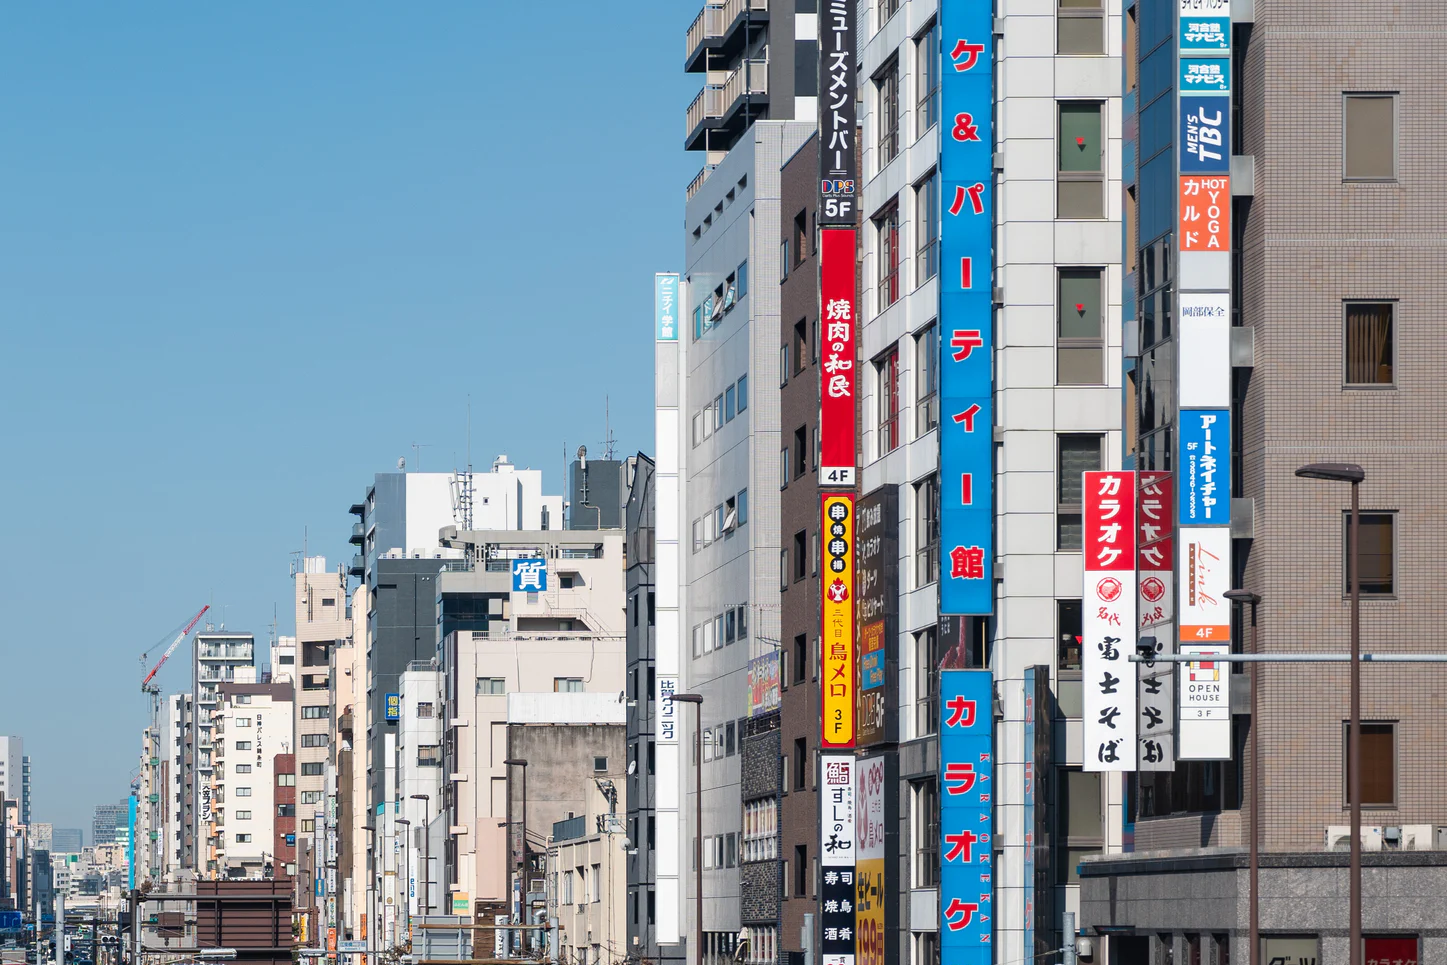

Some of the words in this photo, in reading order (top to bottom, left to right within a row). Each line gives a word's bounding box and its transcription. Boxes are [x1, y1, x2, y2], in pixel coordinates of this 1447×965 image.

[1184, 32, 1225, 43] マナビス
[1188, 23, 1222, 32] 河合塾
[1184, 74, 1225, 84] マナビス
[1188, 65, 1222, 74] 河合塾
[1187, 114, 1199, 154] MEN'S
[1199, 107, 1222, 162] TBC
[822, 180, 855, 193] DPS
[1201, 179, 1227, 189] HOT
[825, 199, 851, 217] 5F
[1183, 179, 1200, 248] カルド
[1207, 191, 1221, 248] YOGA
[661, 284, 674, 339] ニチイ学館
[1182, 306, 1225, 318] 岡部保全
[824, 299, 852, 397] 焼肉の和民
[1187, 442, 1198, 450] 5F
[828, 469, 849, 482] 4F
[1199, 414, 1217, 520] アートネイチャー
[1098, 475, 1122, 567] カラオケ
[513, 561, 547, 590] 質
[833, 609, 844, 638] 三代目
[1096, 606, 1122, 627] 名代
[1195, 627, 1213, 638] 4F
[829, 642, 848, 698] 鳥メロ
[1098, 636, 1123, 764] 富士そば
[834, 709, 843, 734] 3F
[824, 787, 851, 855] すしの和
[824, 872, 853, 885] 寿司
[824, 900, 853, 914] 焼鳥
[824, 928, 853, 942] 酒肴
